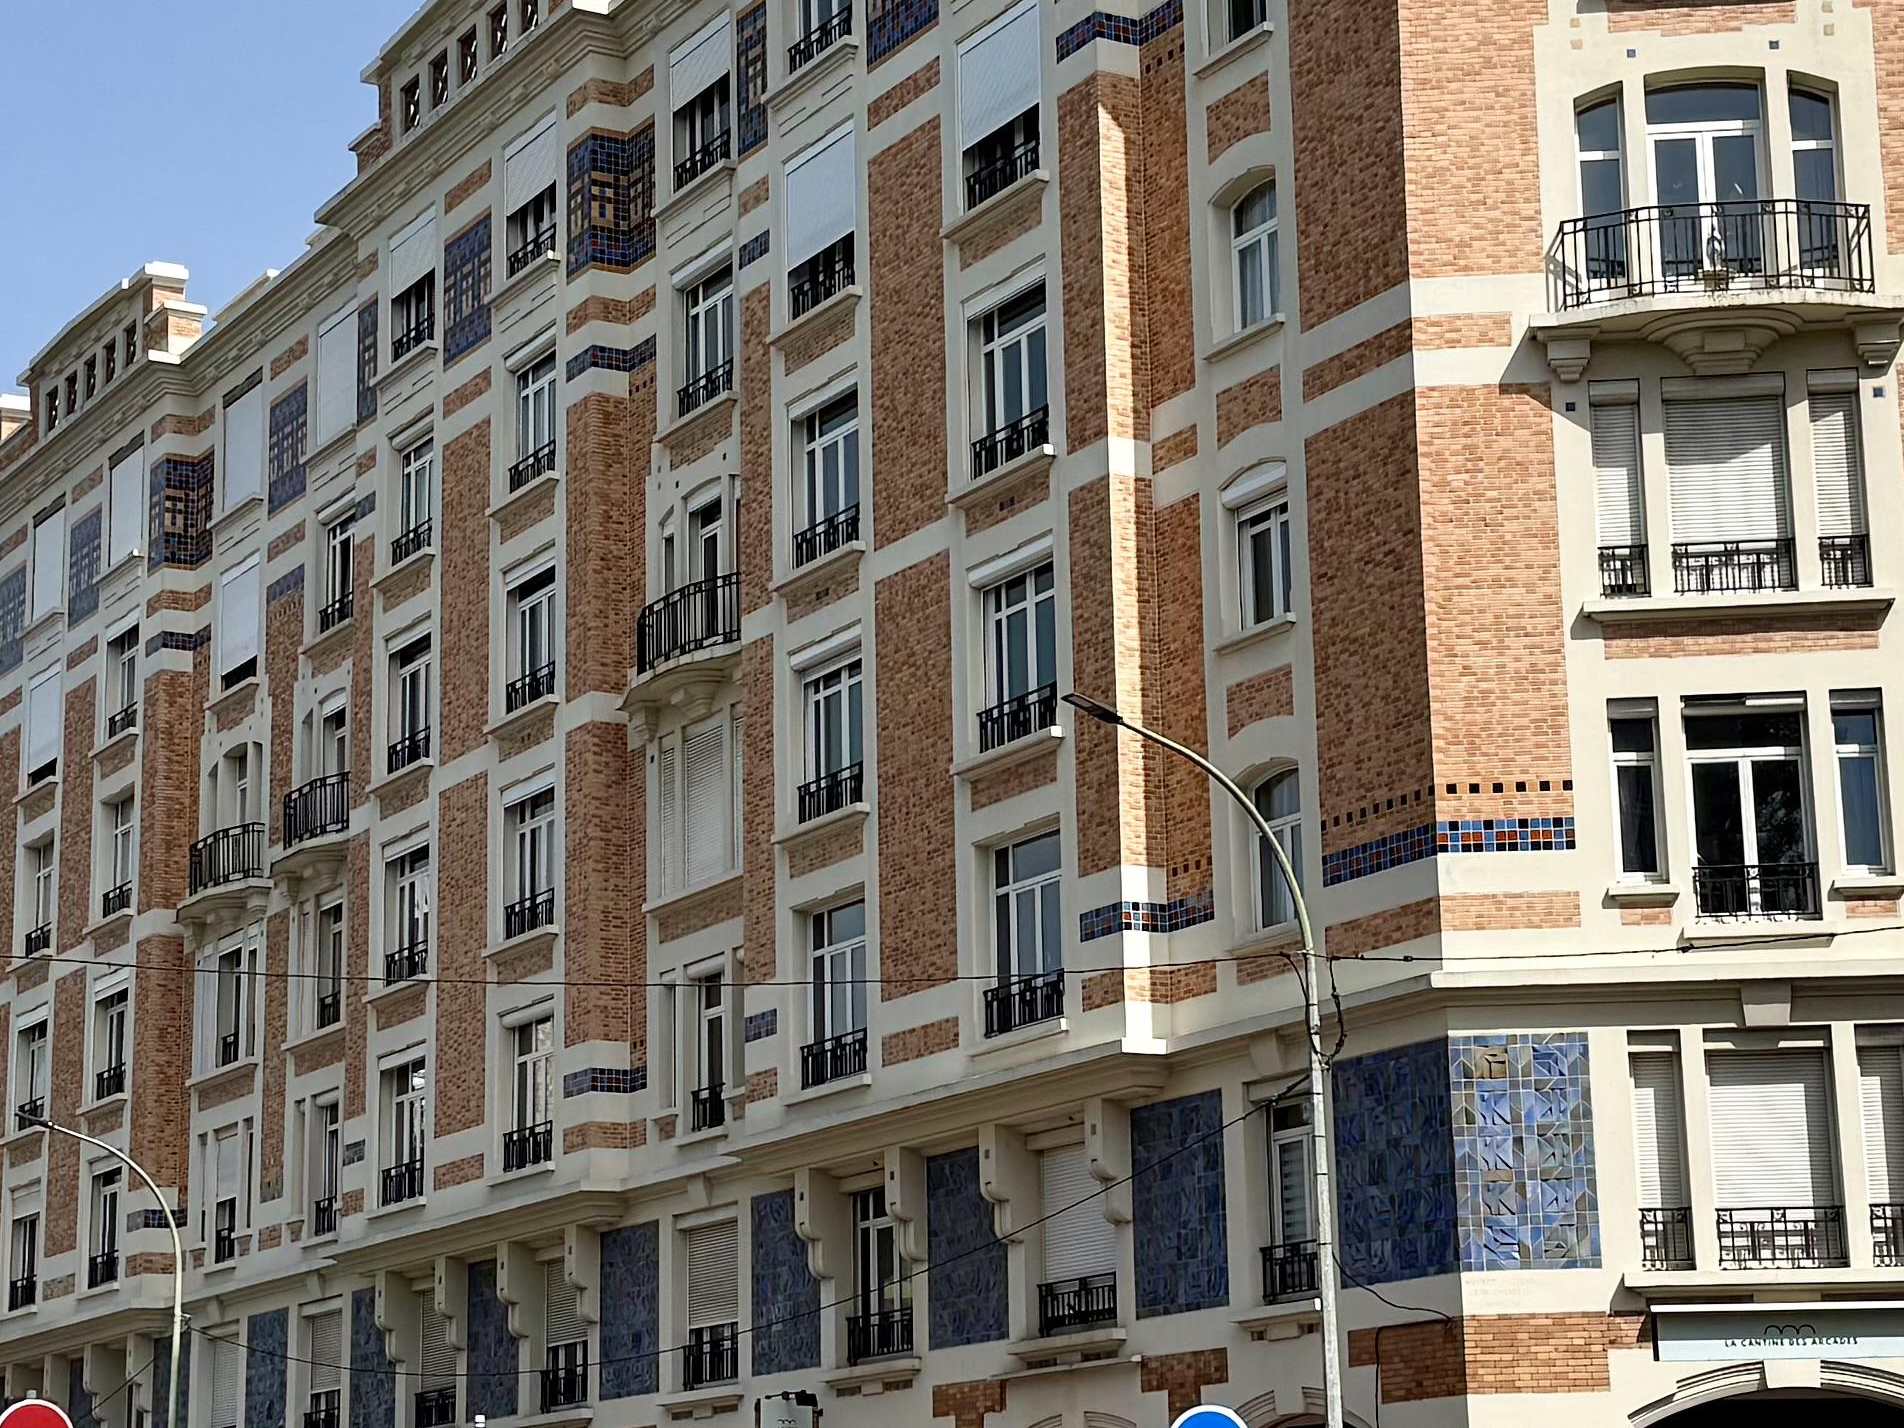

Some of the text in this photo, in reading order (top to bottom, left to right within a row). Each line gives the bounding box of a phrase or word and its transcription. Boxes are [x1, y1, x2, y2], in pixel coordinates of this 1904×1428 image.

[1741, 1339, 1784, 1347] CANTINE
[1789, 1338, 1807, 1346] DES
[1811, 1337, 1858, 1345] ARCADES
